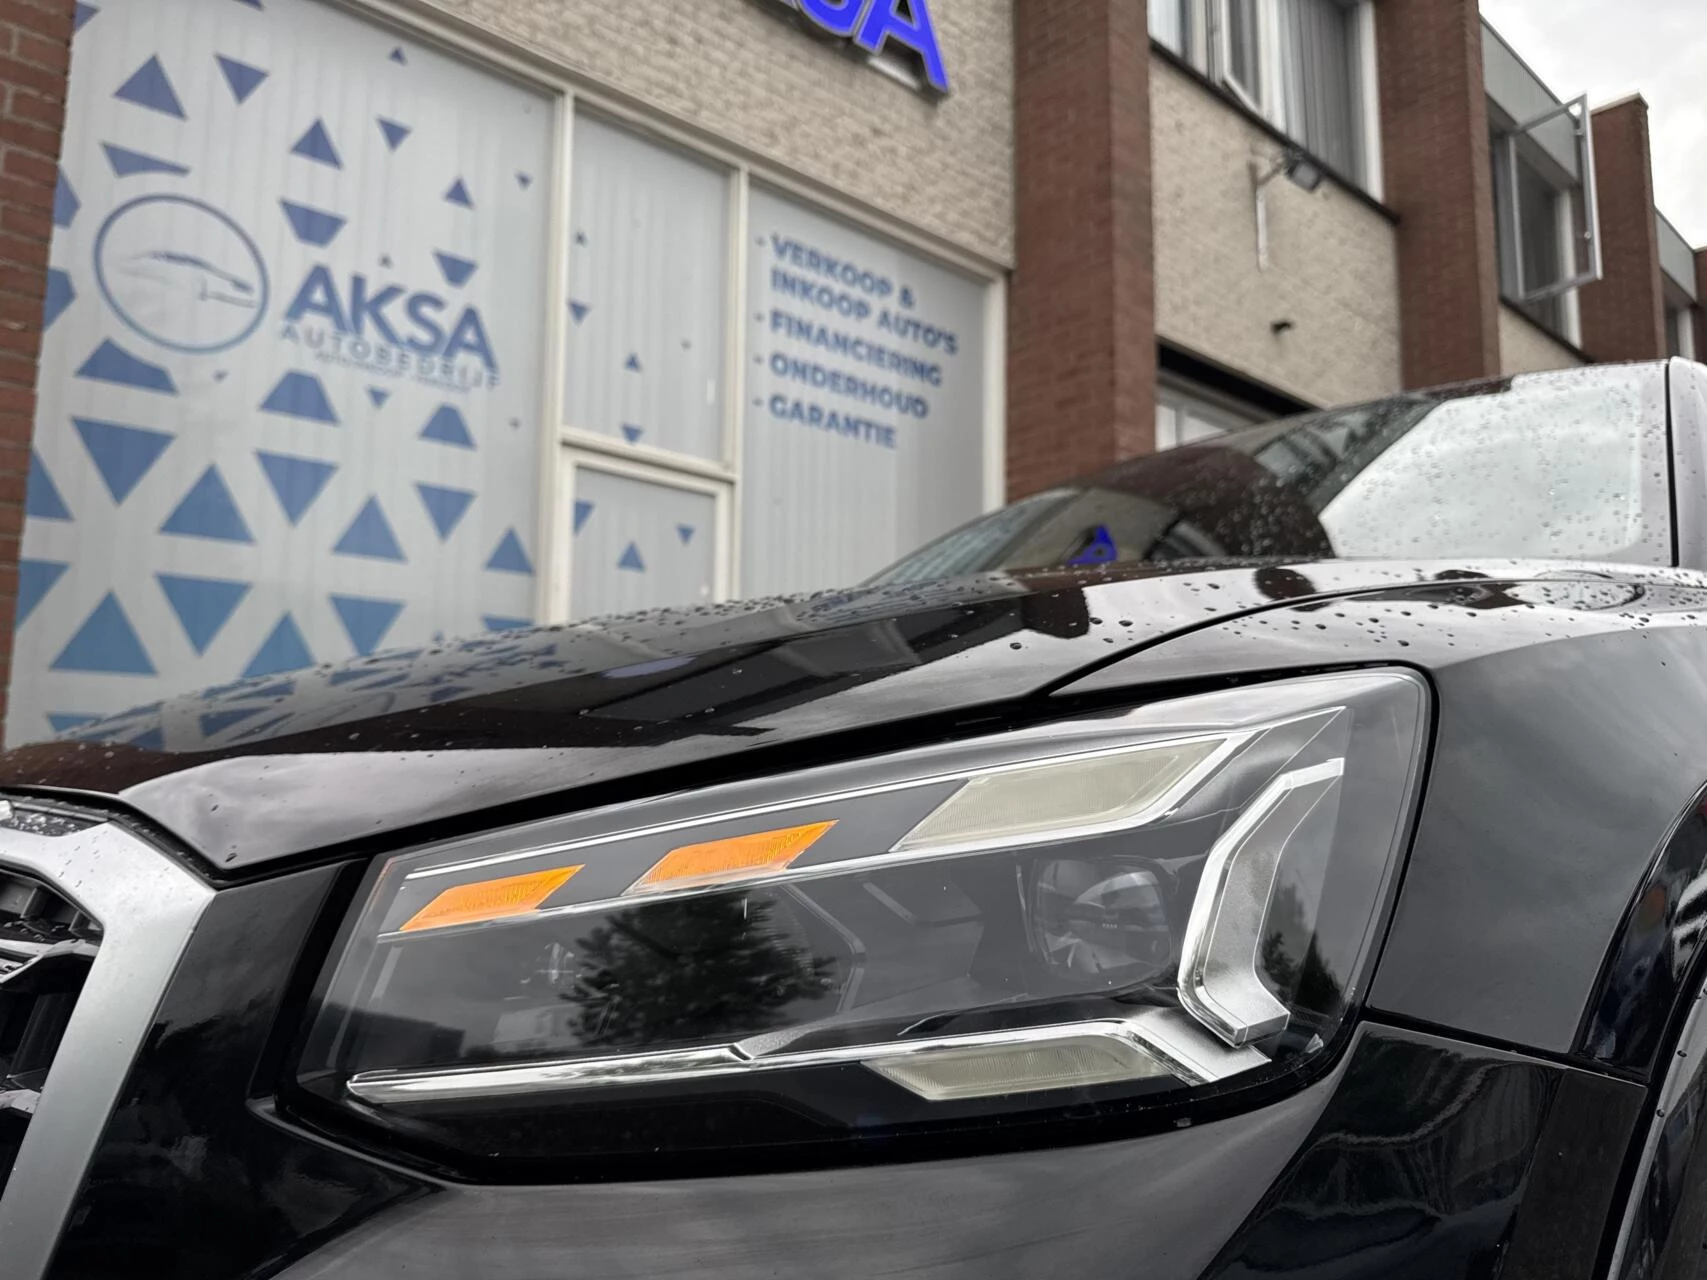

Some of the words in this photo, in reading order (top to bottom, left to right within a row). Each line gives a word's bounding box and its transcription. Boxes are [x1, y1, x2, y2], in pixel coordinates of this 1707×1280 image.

[772, 234, 893, 295] VERKOOP
[900, 285, 915, 309] &
[285, 263, 499, 373] AKSA
[770, 269, 870, 320] INKOOP
[878, 310, 958, 355] AUTO'S
[770, 310, 942, 387] FINANCIERING
[279, 322, 499, 390] AUTOBEDRIJF
[769, 352, 929, 420] ONDERHOUD
[769, 394, 897, 449] GARANTIE
